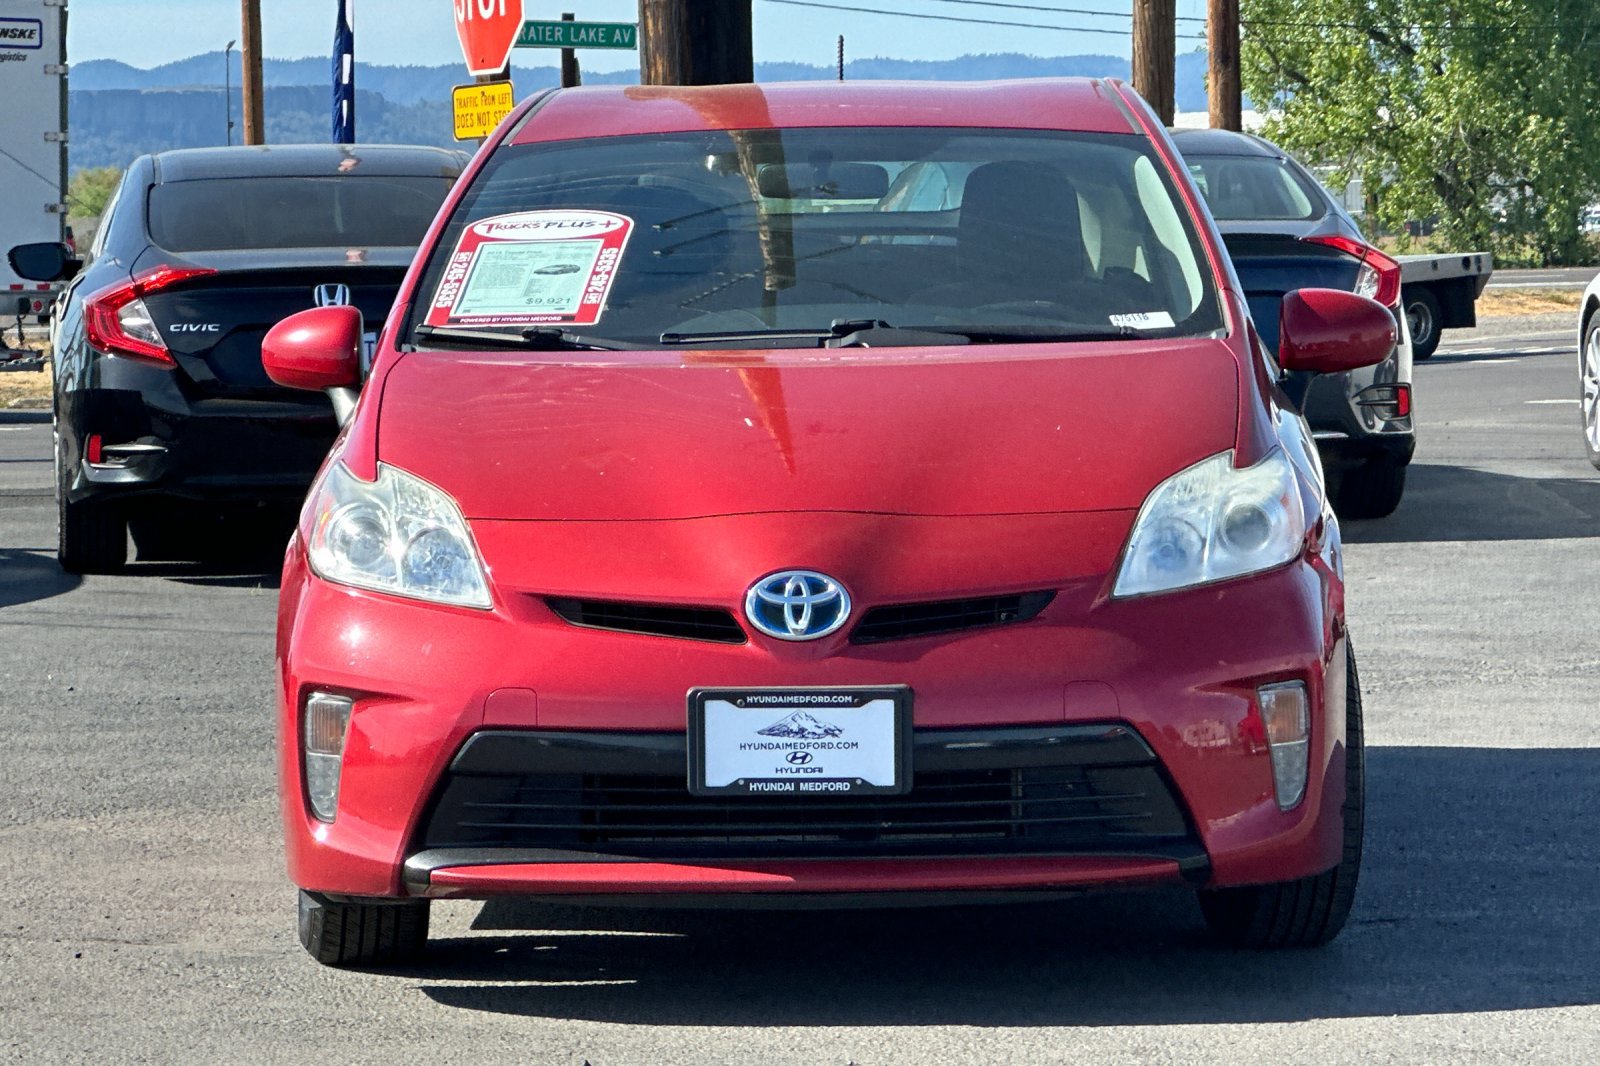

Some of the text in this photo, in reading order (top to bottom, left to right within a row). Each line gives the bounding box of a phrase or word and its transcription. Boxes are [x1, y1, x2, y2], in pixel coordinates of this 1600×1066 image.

[0, 28, 37, 39] NSKE
[518, 26, 632, 43] RATER LAKE AV
[0, 51, 27, 62] gistics
[456, 93, 510, 109] TRAFFIC FROM LEFT
[456, 109, 510, 129] DOES NOT ST
[170, 323, 220, 332] CIVIC
[747, 695, 852, 704] HYUNDAIMEDFORD.COM
[739, 742, 859, 750] HYUNDAIMEDFORD.COM
[749, 781, 850, 792] HYUNDAI MEDFORD
